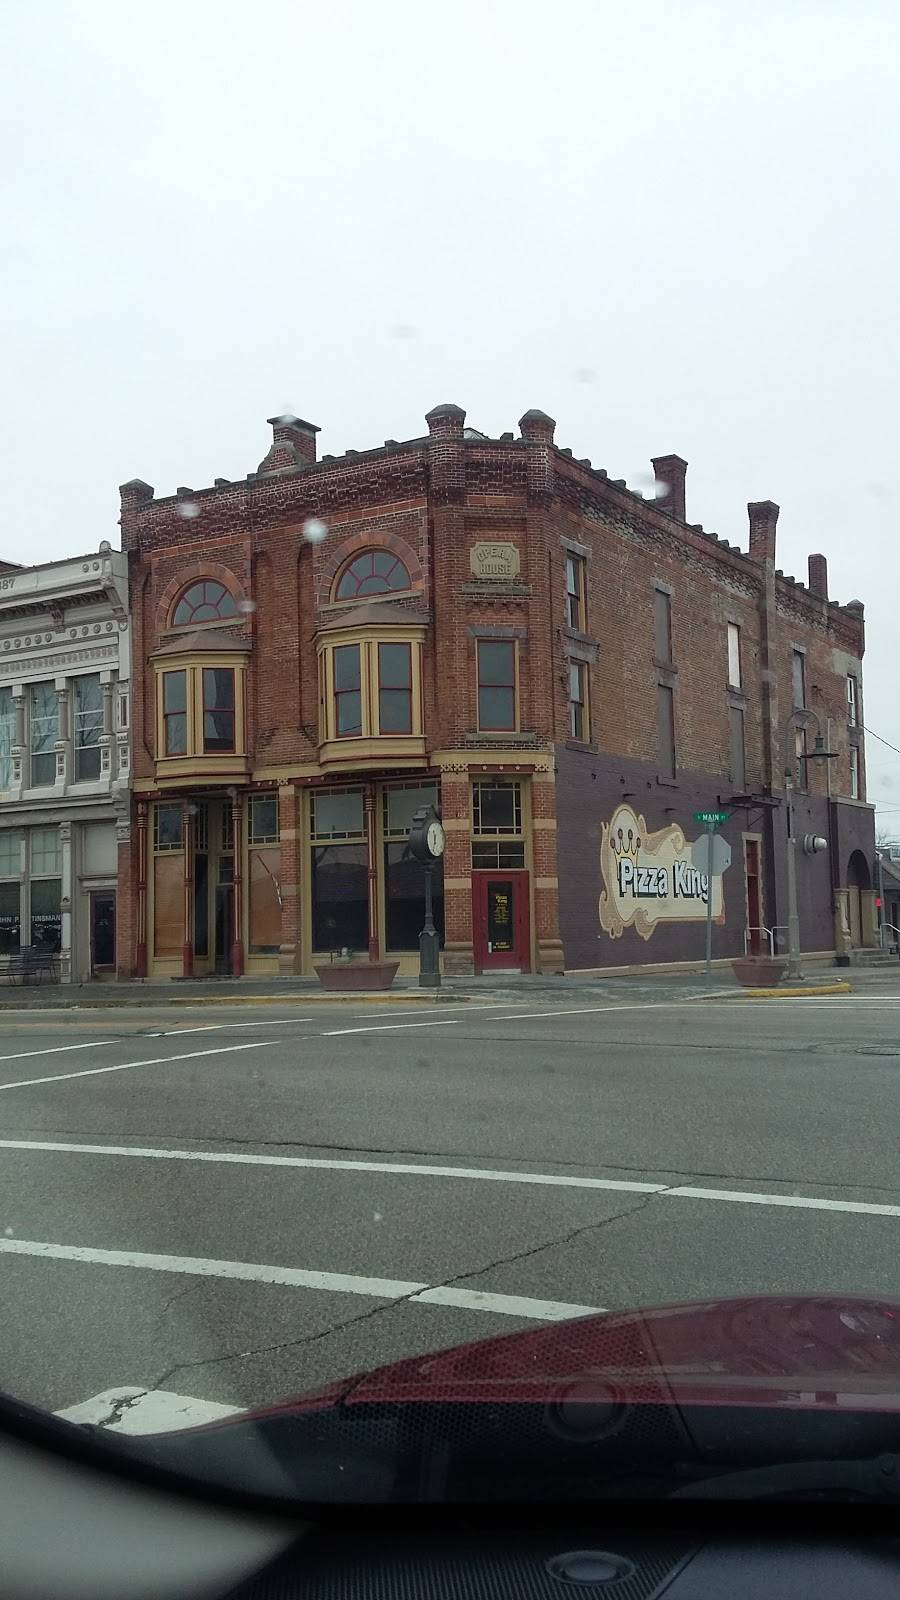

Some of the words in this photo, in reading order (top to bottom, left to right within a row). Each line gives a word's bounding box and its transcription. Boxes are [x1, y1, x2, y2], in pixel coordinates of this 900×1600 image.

[480, 562, 512, 575] HOUSE
[0, 578, 15, 590] 87
[702, 813, 720, 821] MAIN
[619, 857, 669, 898] Pizza
[673, 860, 709, 904] King
